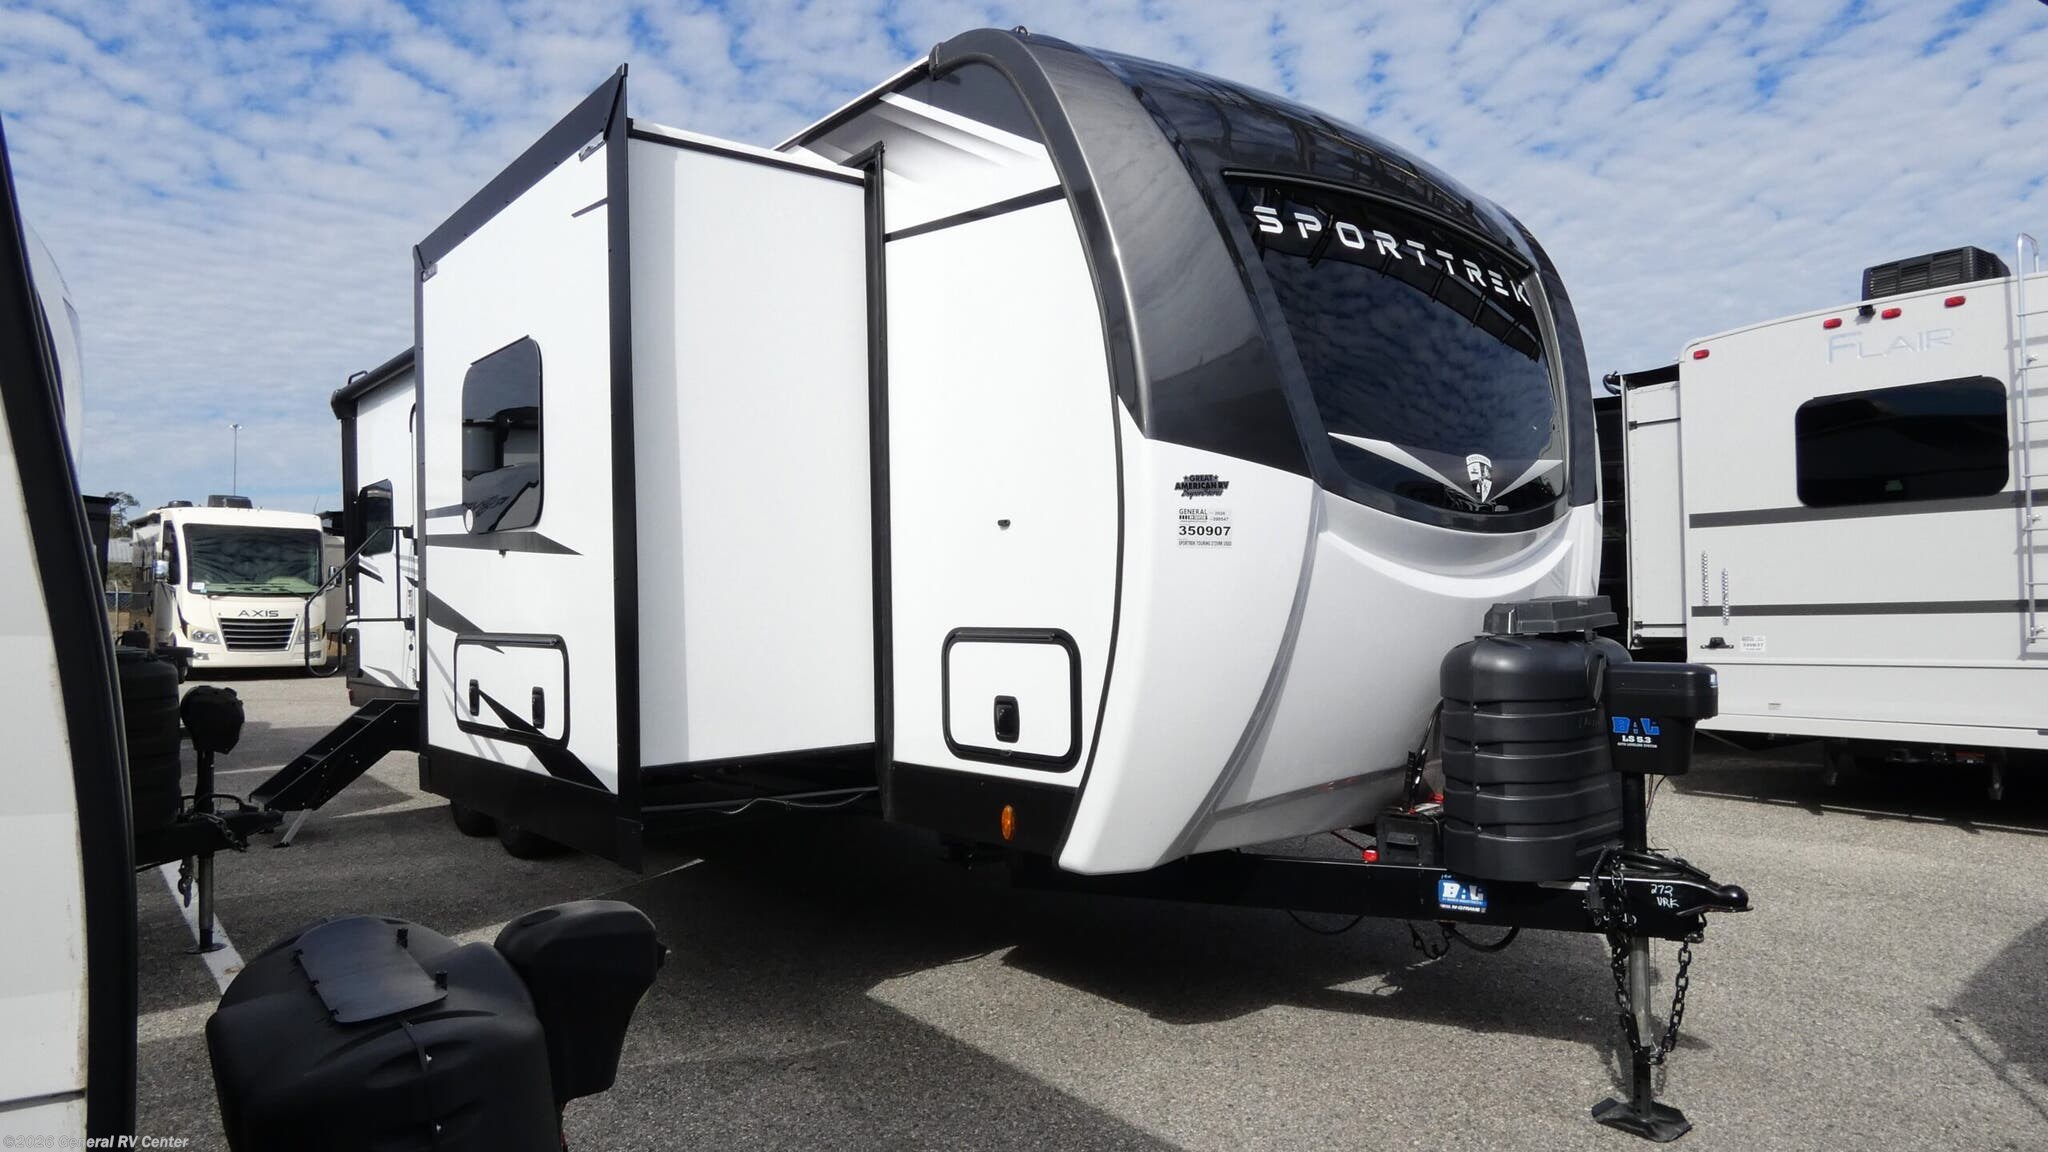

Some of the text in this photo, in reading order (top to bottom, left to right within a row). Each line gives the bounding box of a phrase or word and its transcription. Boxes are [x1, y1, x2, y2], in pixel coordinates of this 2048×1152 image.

[1253, 205, 1531, 306] SPORTTREK
[1826, 328, 1955, 364] FLAIR
[1175, 481, 1229, 490] AMERICAN RV
[1178, 525, 1231, 536] 350907
[238, 610, 279, 618] AXIS
